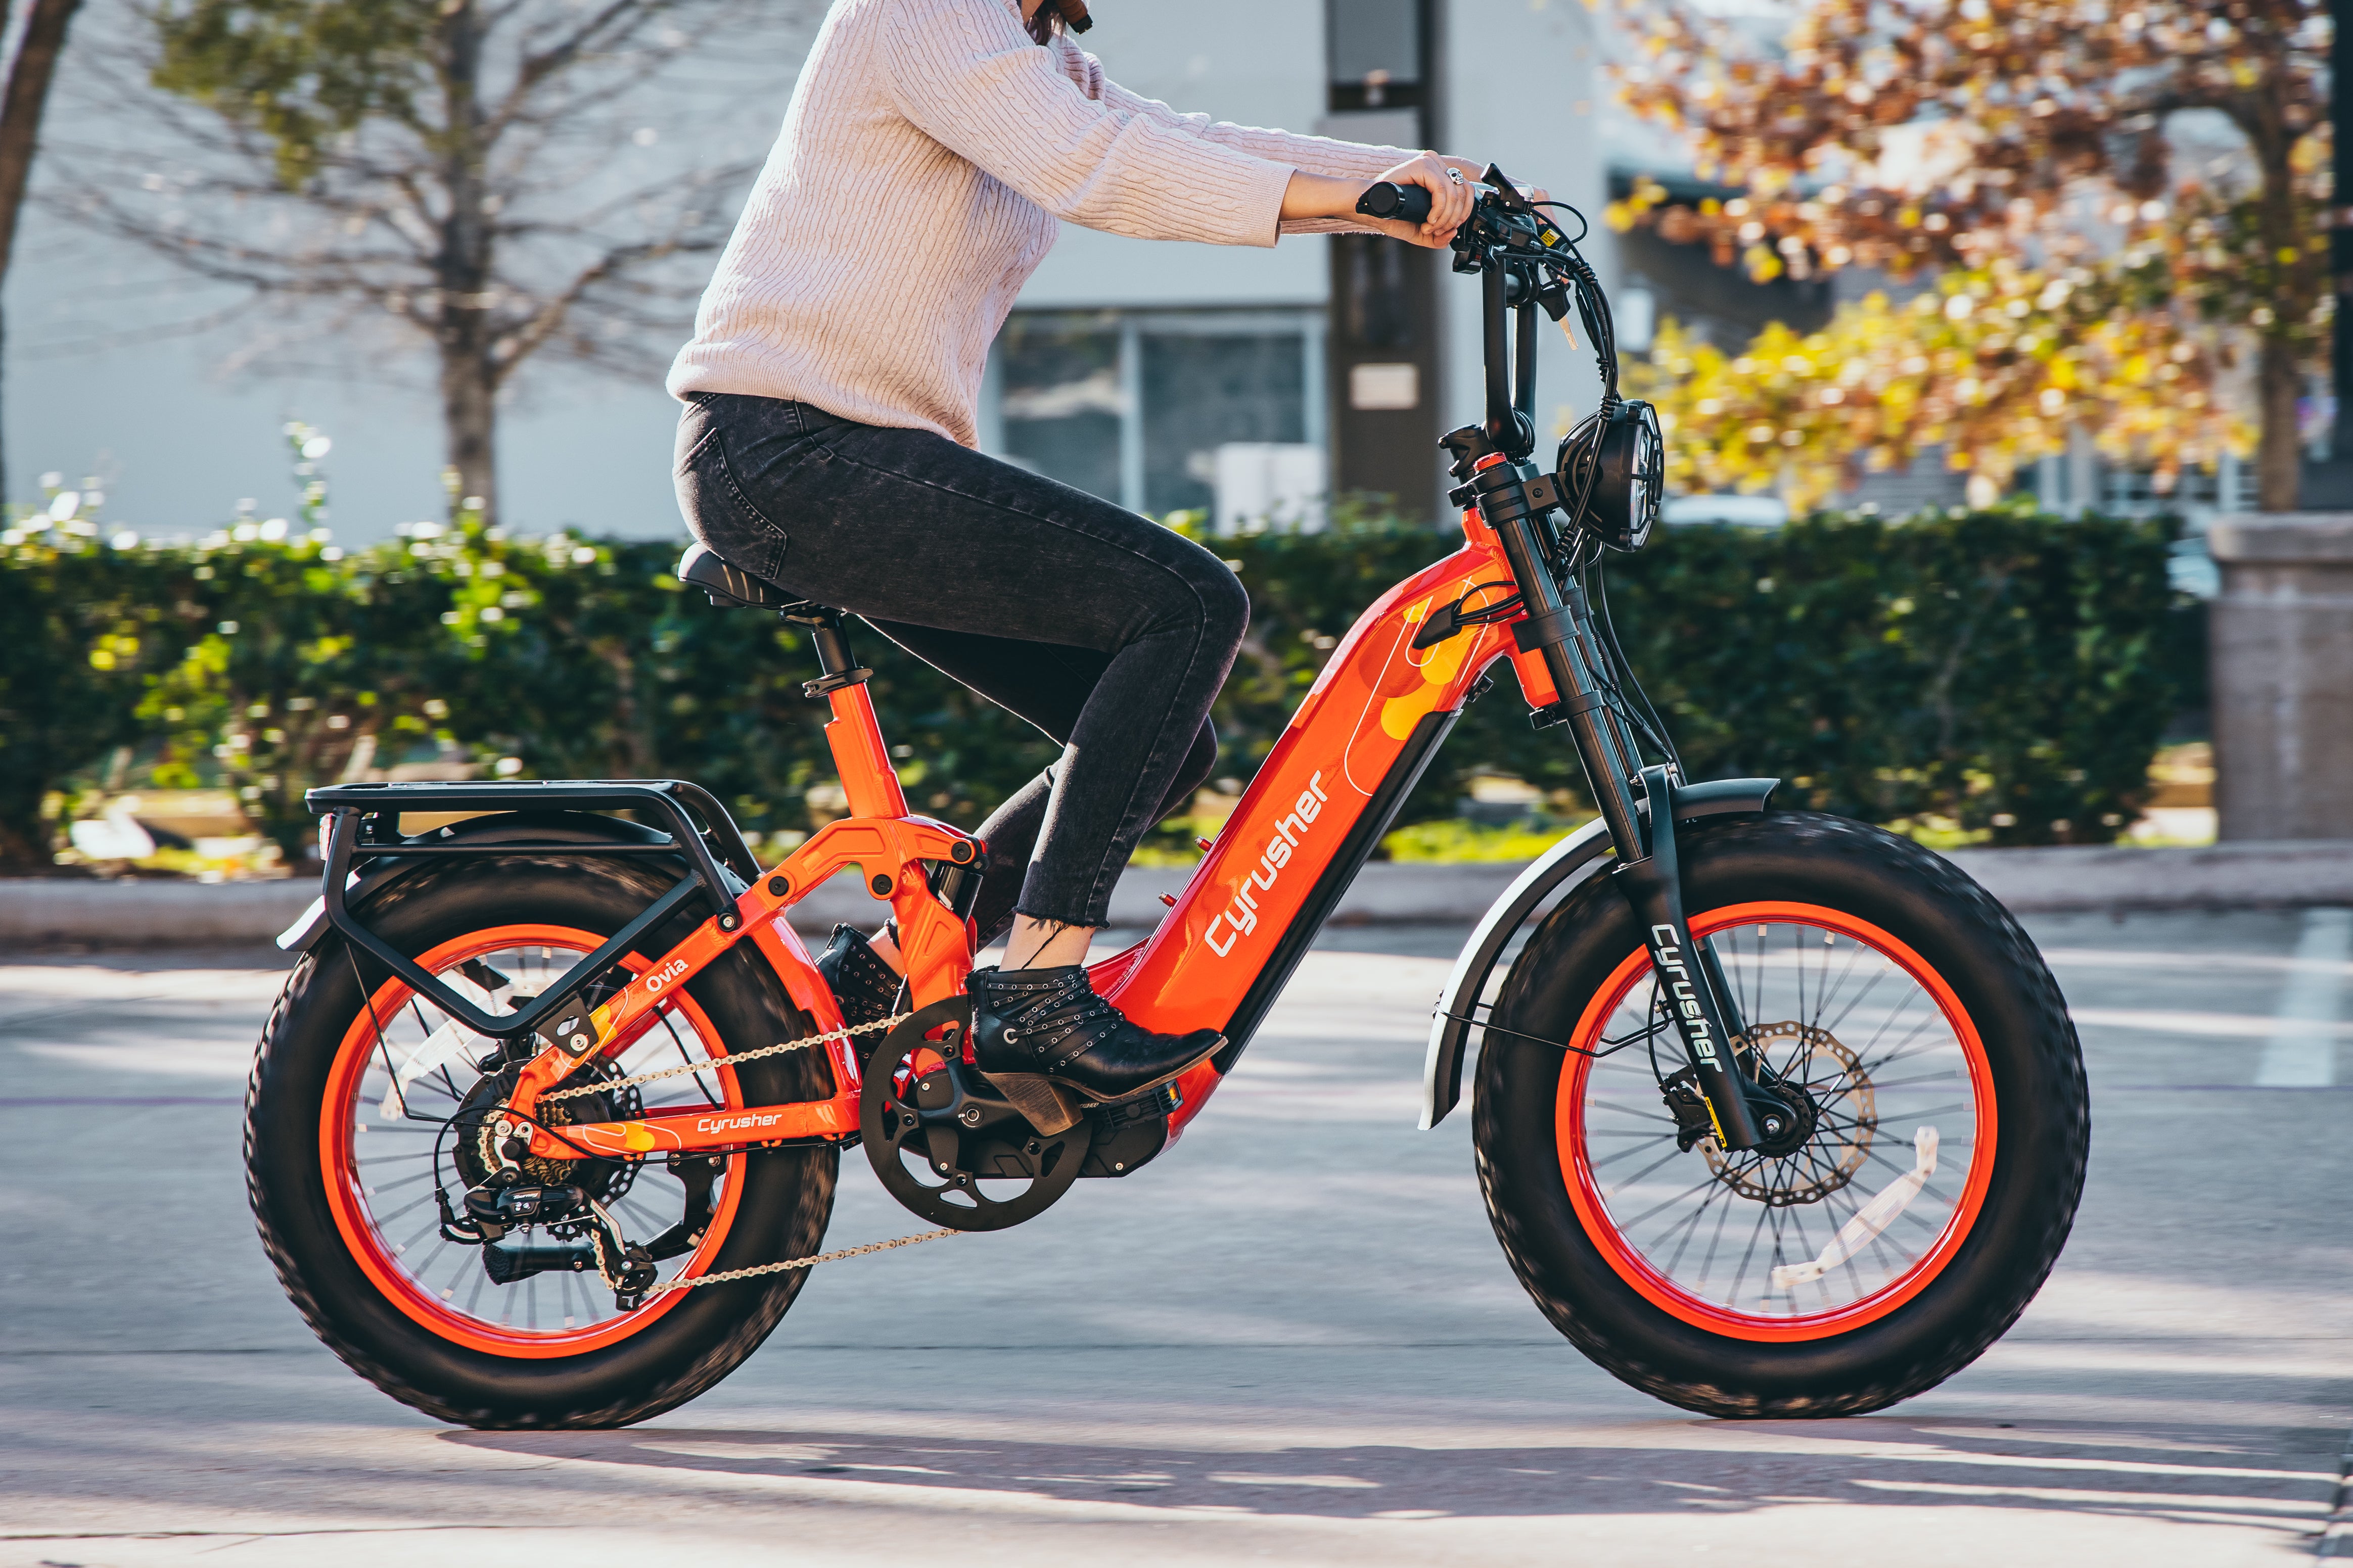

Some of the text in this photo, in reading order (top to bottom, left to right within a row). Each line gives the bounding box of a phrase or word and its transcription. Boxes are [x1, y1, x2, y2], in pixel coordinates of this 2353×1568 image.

[1205, 770, 1328, 958] Cyrusher
[646, 959, 688, 992] Ovia
[1651, 924, 1723, 1072] Cyrusher
[697, 1114, 782, 1134] Cyrusher
